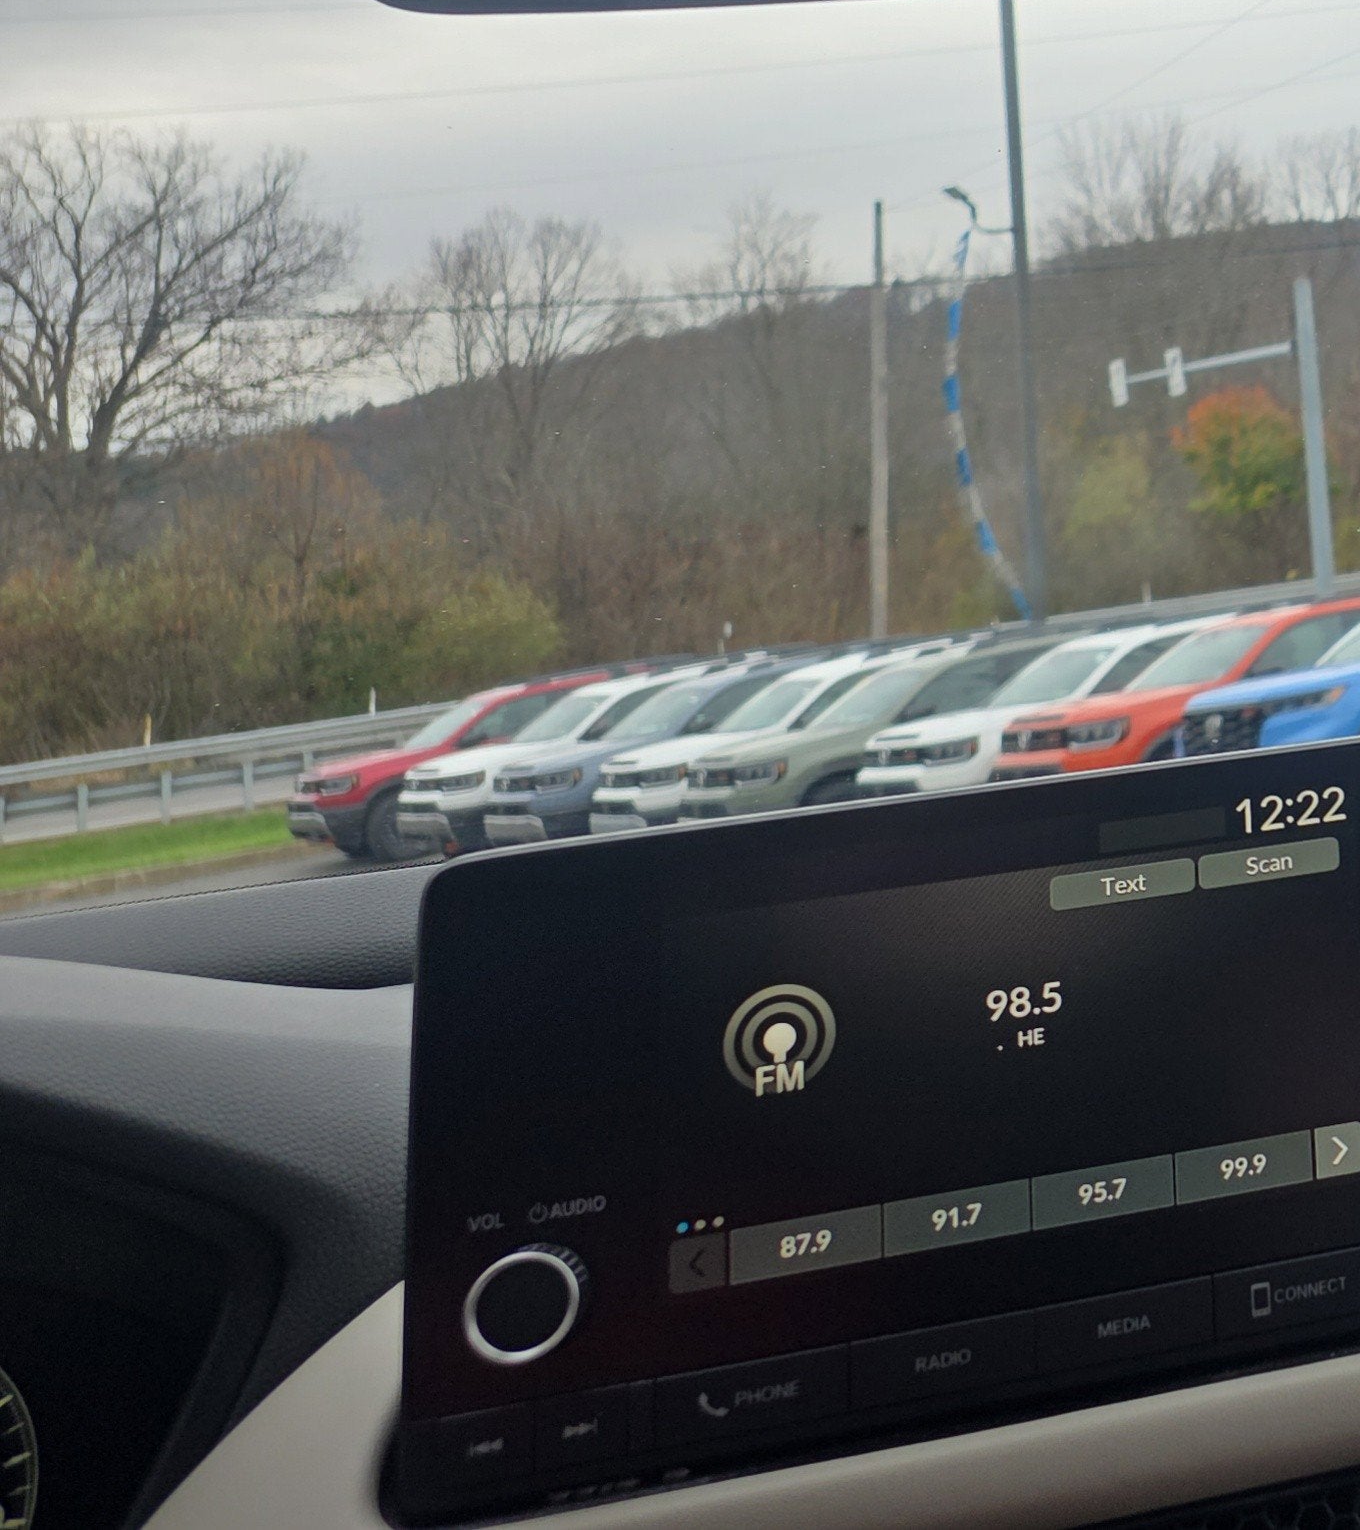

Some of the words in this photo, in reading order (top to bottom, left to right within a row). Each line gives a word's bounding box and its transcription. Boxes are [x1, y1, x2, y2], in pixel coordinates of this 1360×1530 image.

[1235, 786, 1347, 834] 12:22
[1245, 855, 1293, 875] Scan
[1100, 873, 1147, 896] Text
[985, 981, 1062, 1022] 98.5
[1016, 1027, 1046, 1047] HE
[755, 1060, 805, 1097] FM
[1219, 1153, 1267, 1181] 99.9
[1078, 1177, 1127, 1206] 95.7
[549, 1194, 607, 1219] AUDIO
[931, 1202, 982, 1232] 91.7
[467, 1212, 505, 1232] VOL
[780, 1229, 832, 1258] 87.9
[1273, 1276, 1347, 1304] CONNECT
[1097, 1314, 1151, 1339] MEDIA
[915, 1348, 972, 1372] RADIO
[734, 1379, 800, 1407] PHONE
